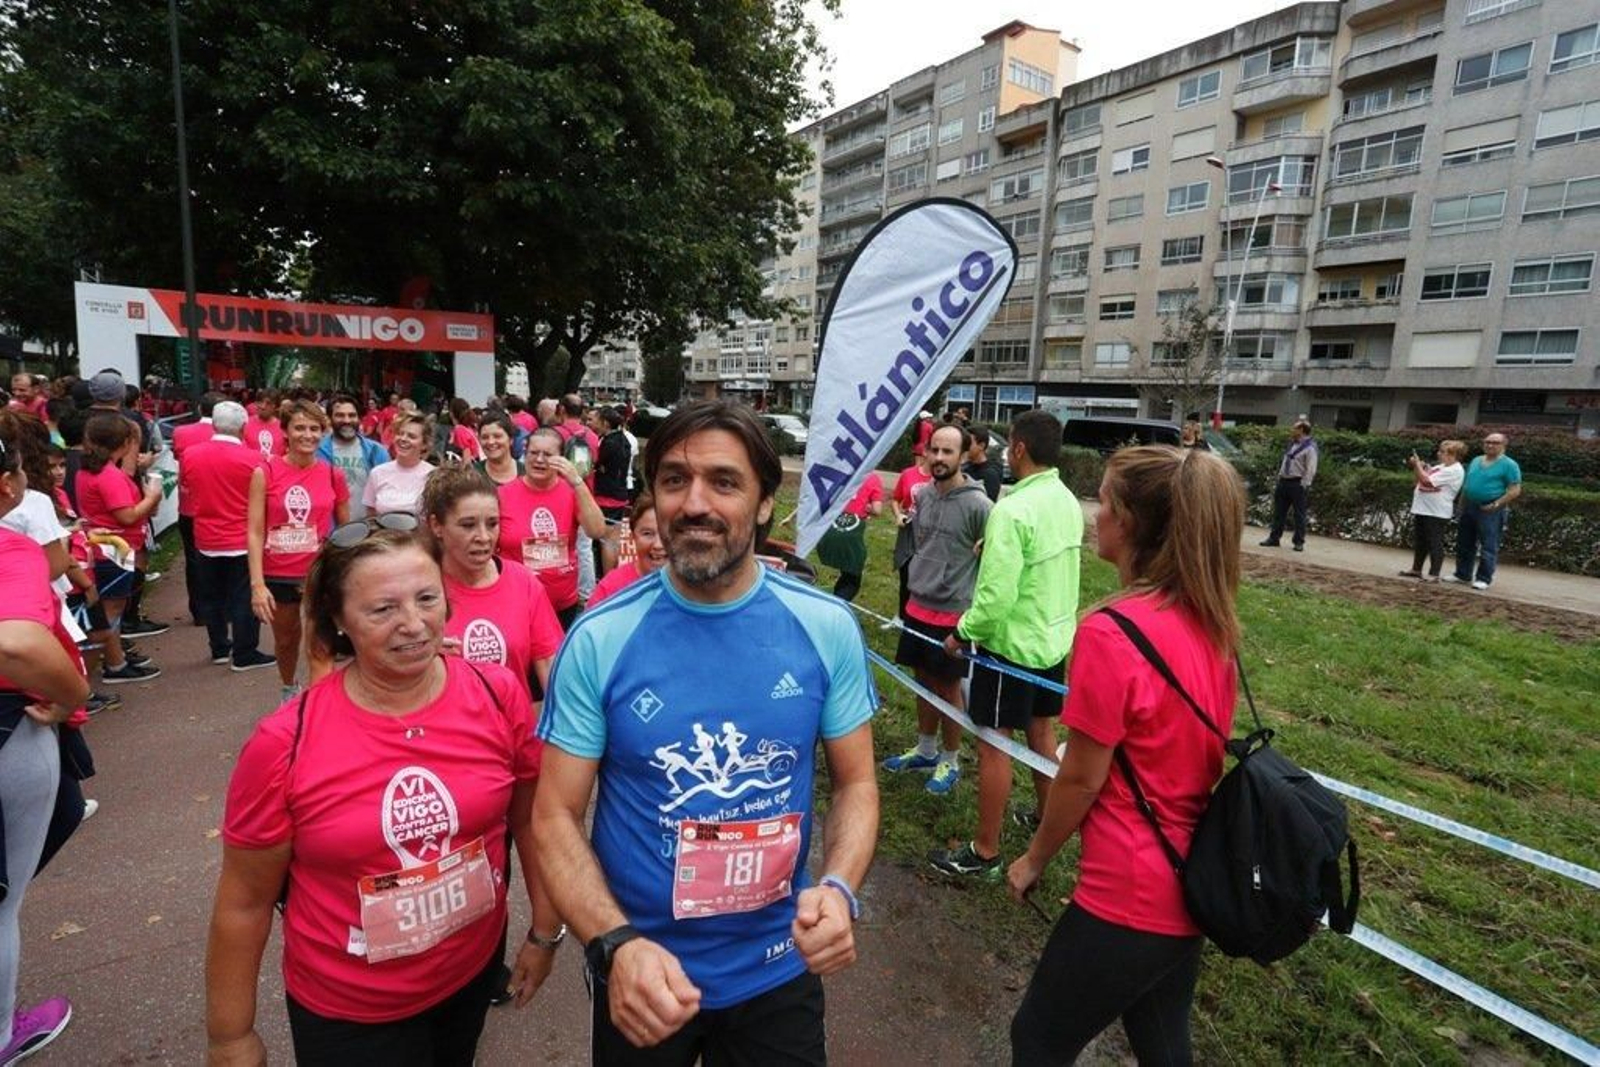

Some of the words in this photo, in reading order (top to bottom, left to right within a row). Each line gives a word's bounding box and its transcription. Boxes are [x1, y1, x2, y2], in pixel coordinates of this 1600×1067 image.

[807, 249, 995, 517] Atlántico
[771, 687, 803, 700] adidas
[400, 777, 425, 797] VI
[393, 801, 443, 822] VIGO
[724, 851, 764, 887] 181
[396, 878, 467, 931] 3106
